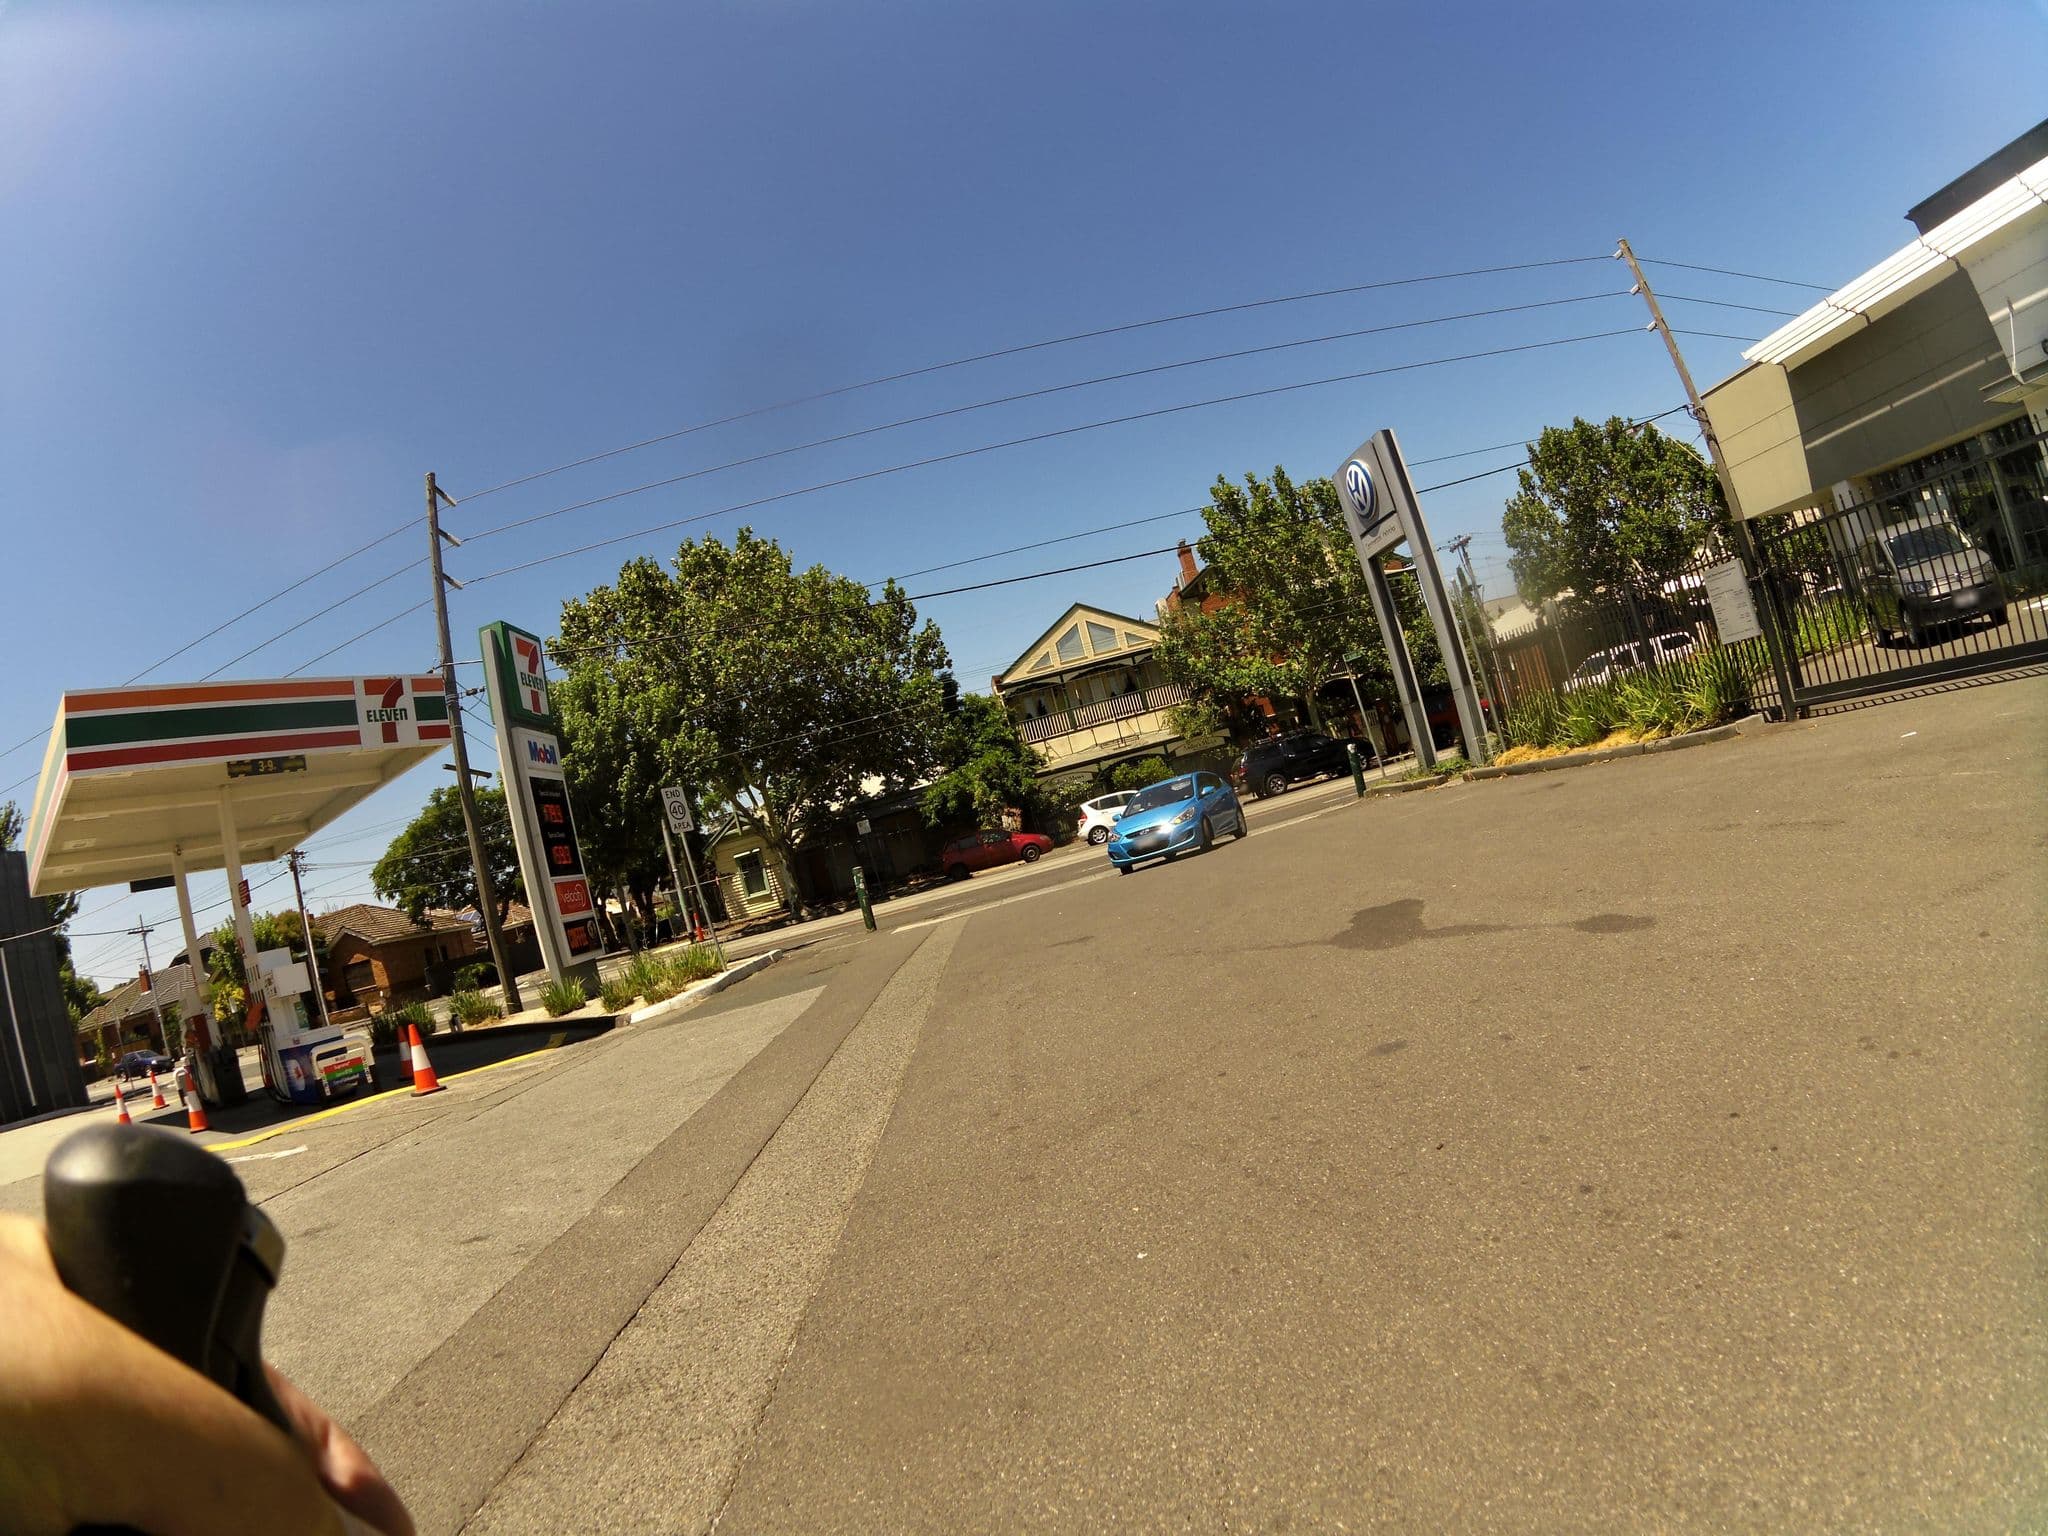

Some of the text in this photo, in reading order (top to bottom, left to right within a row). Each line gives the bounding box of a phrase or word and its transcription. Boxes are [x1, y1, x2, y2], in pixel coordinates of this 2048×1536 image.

[515, 637, 541, 714] 7
[363, 679, 404, 743] 7
[527, 740, 558, 765] Mobil
[665, 790, 680, 799] END
[672, 805, 684, 815] 40
[673, 822, 690, 830] AREA
